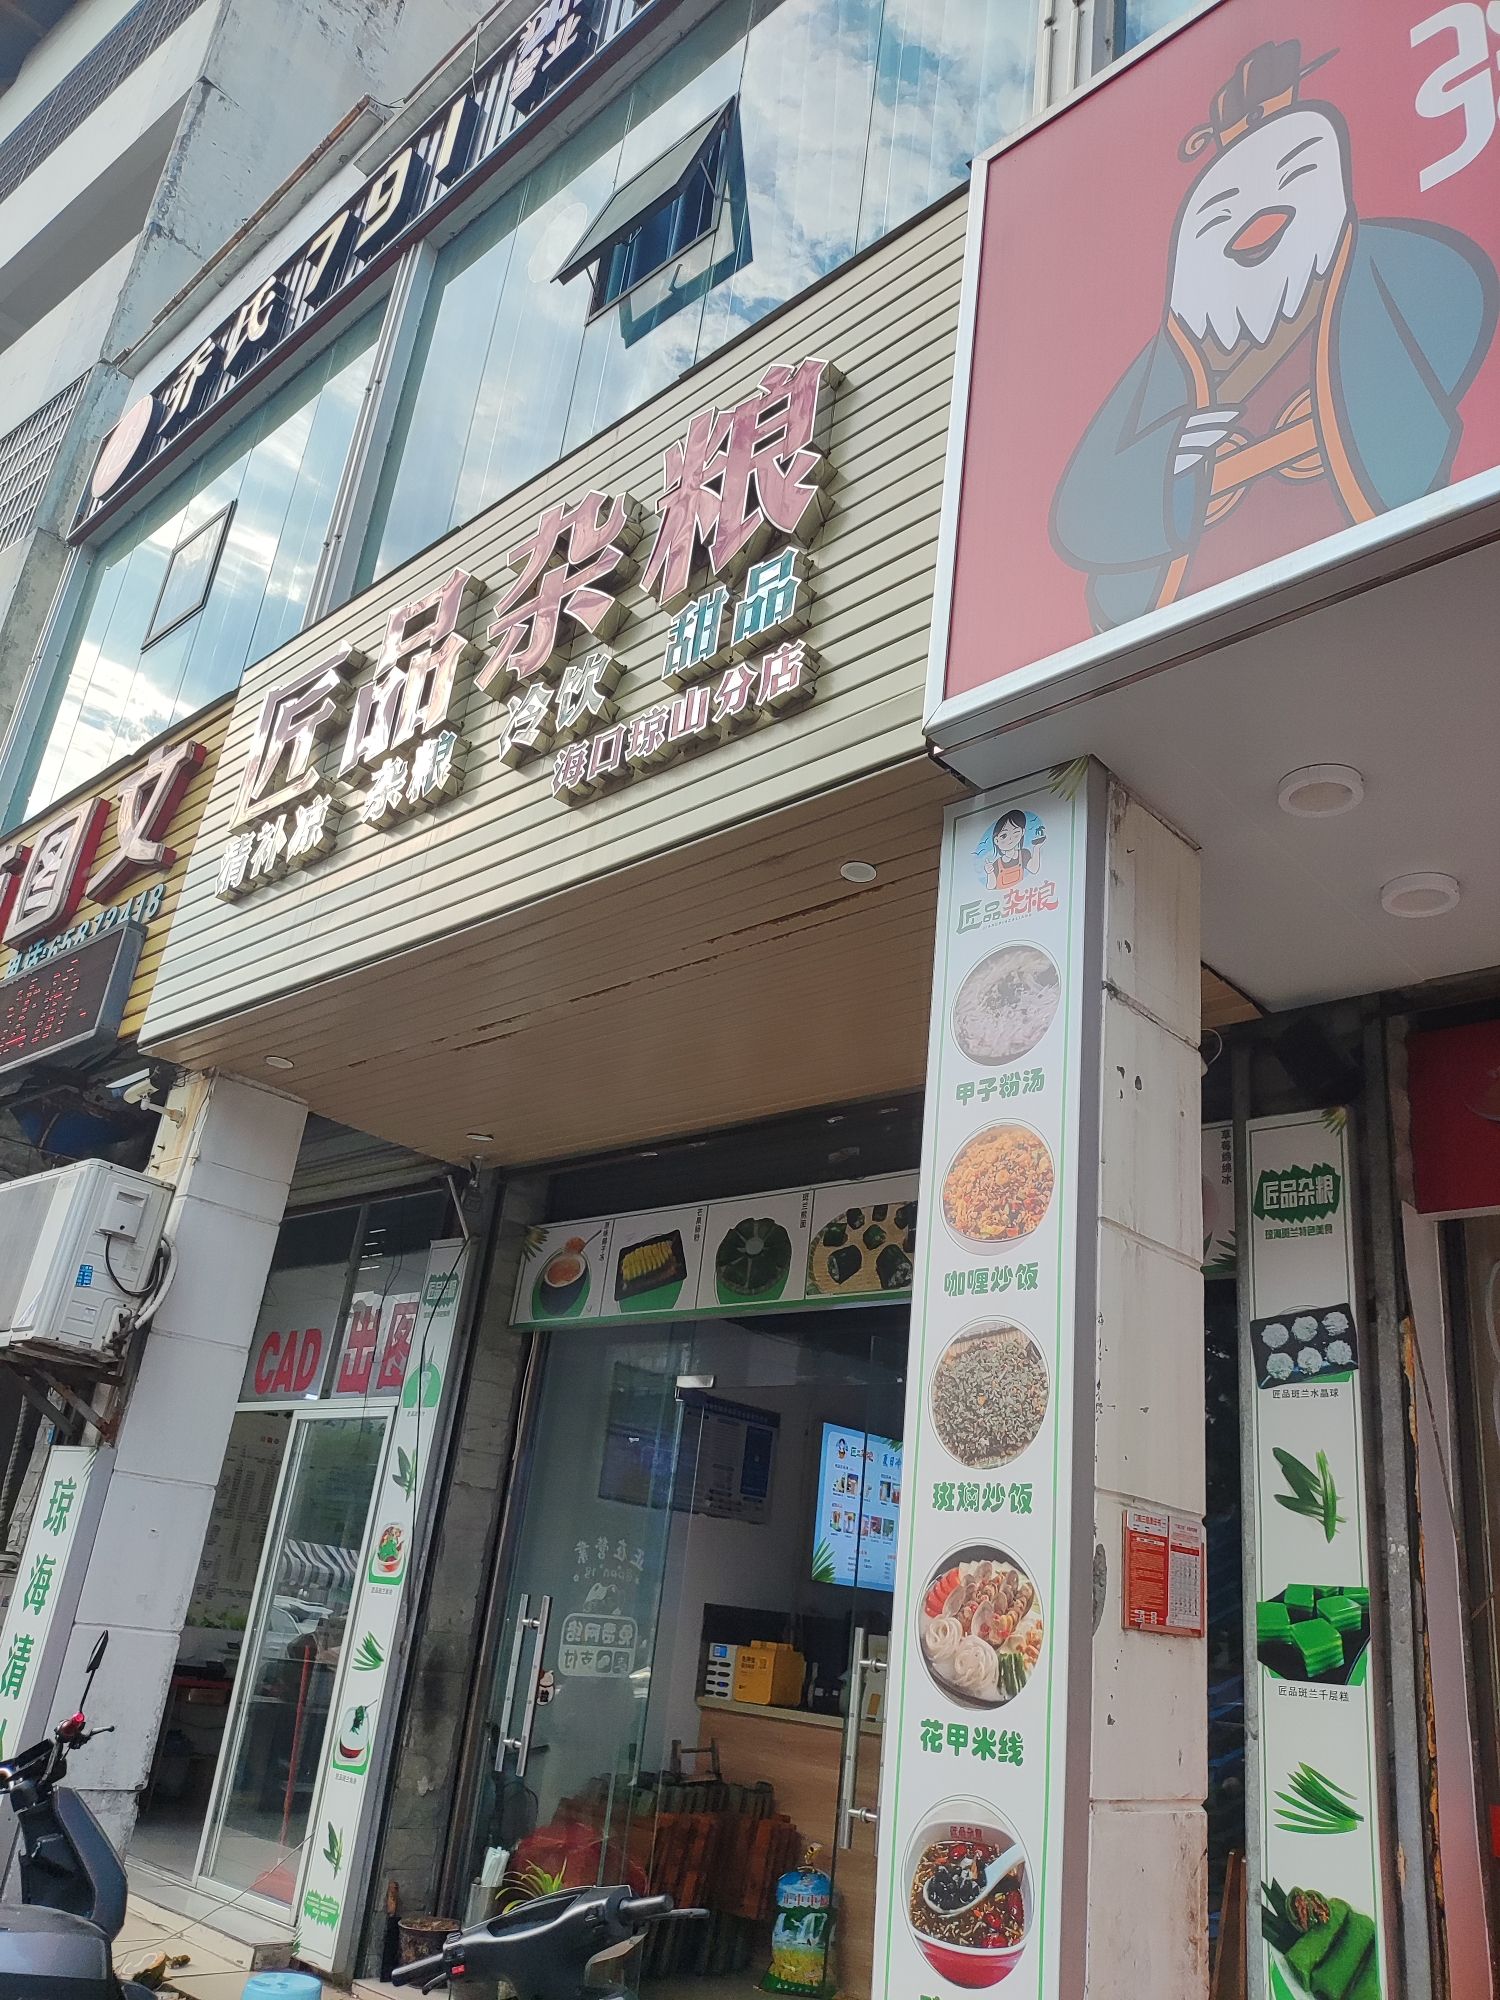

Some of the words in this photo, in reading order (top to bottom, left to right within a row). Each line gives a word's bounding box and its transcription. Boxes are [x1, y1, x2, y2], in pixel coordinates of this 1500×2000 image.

[509, 13, 581, 104] 营业
[229, 358, 829, 831] 匠品杂粮
[215, 794, 332, 898] 清补凉
[362, 730, 457, 823] 杂粮
[499, 653, 612, 753] 冷饮
[662, 546, 802, 680] 甜品
[552, 639, 806, 796] 海口琼山分店
[0, 741, 194, 946] 图文
[956, 880, 1059, 934] 匠品杂粮
[956, 1068, 1044, 1106] 甲子粉汤
[944, 1262, 1038, 1297] 咖喱炒饭
[254, 1328, 322, 1395] CAD
[336, 1301, 420, 1395] 出图
[0, 1475, 77, 1760] 琼海清
[920, 1719, 1024, 1766] 花甲米线
